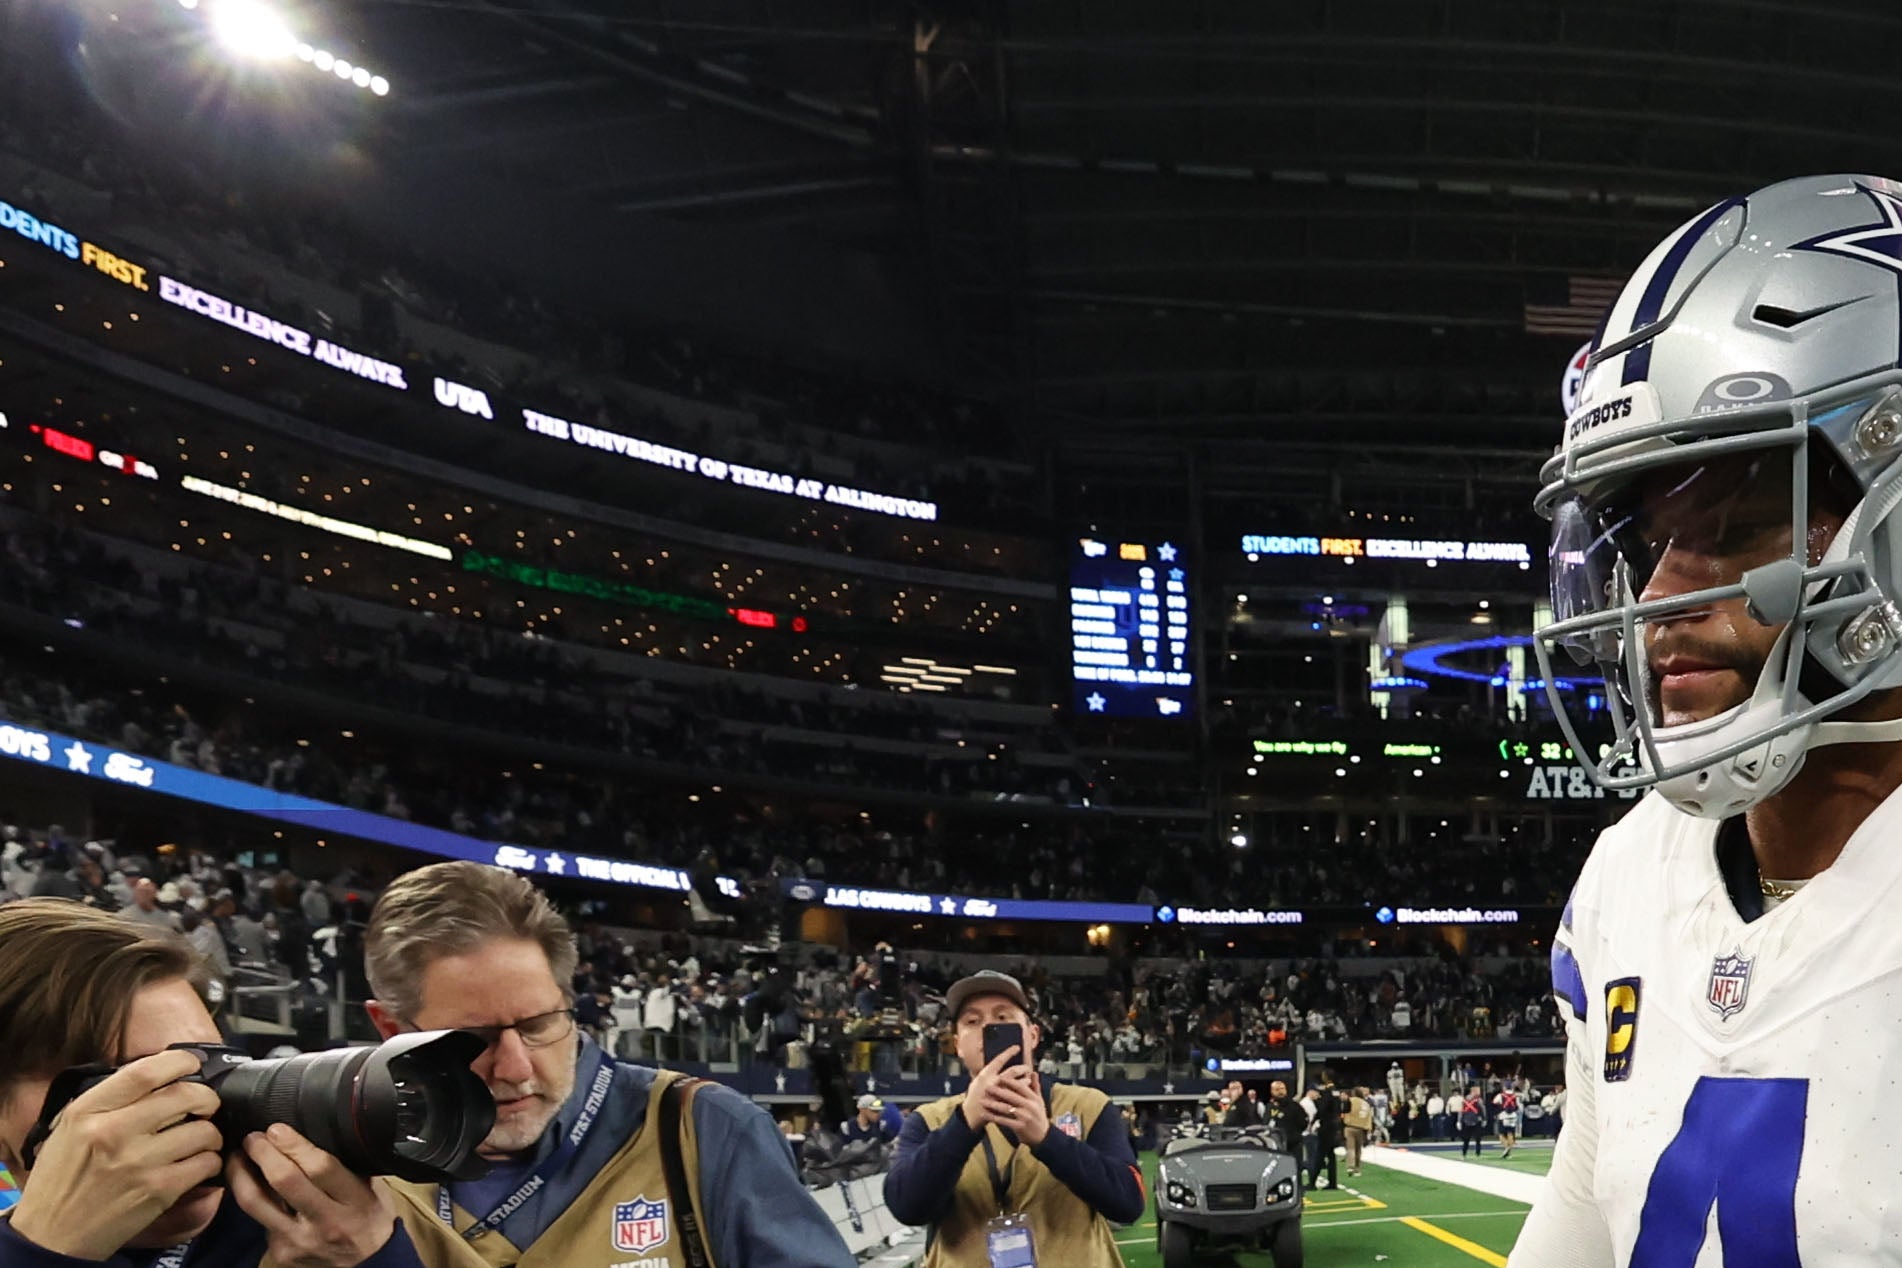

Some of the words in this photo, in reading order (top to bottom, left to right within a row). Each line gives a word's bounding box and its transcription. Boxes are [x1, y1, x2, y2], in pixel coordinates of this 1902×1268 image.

[0, 203, 80, 260] DENTS
[81, 241, 149, 291] FIRST.
[159, 275, 311, 356] EXCELLENCE
[313, 338, 408, 389] ALWAYS.
[434, 378, 493, 419] UTA
[1570, 396, 1632, 441] COWBOYS
[523, 409, 569, 440] THE
[571, 423, 699, 471] UNIVERSITY
[700, 457, 727, 480] OF
[729, 464, 793, 494] TEXAS
[795, 478, 824, 500] AT
[825, 485, 936, 520] ARLINGTON
[1242, 535, 1319, 554] STUDENTS
[1321, 538, 1363, 556] FIRST.
[1366, 539, 1464, 559] EXCELLENCE
[1177, 908, 1302, 924] Blockchain.com
[1397, 907, 1518, 923] Blockchain.com
[1711, 978, 1742, 1006] NFL
[1607, 985, 1636, 1054] C
[569, 1111, 590, 1146] AT&T
[586, 1065, 615, 1115] STADIUM
[487, 1174, 544, 1225] STADIUM
[619, 1221, 661, 1246] NFL
